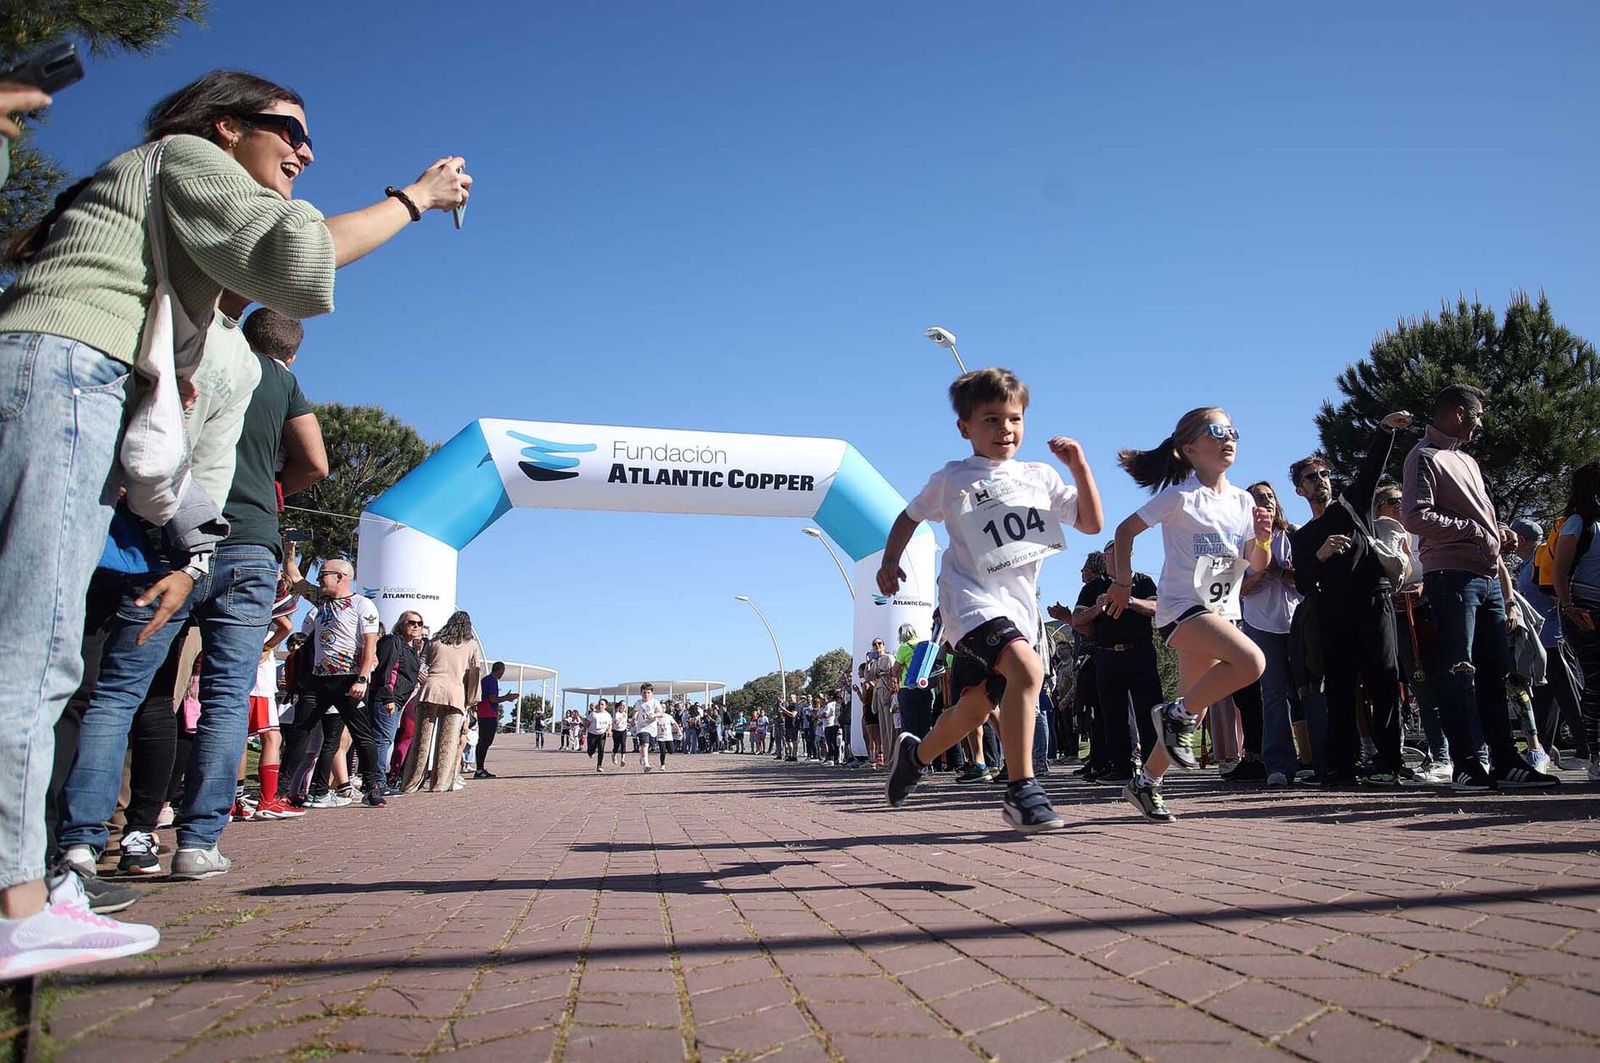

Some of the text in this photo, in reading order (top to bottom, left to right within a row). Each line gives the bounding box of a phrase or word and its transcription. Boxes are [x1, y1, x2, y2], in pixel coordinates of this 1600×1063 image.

[613, 440, 727, 464] Fundación
[608, 463, 814, 491] ATLANTIC COPPER
[982, 506, 1045, 548] 104
